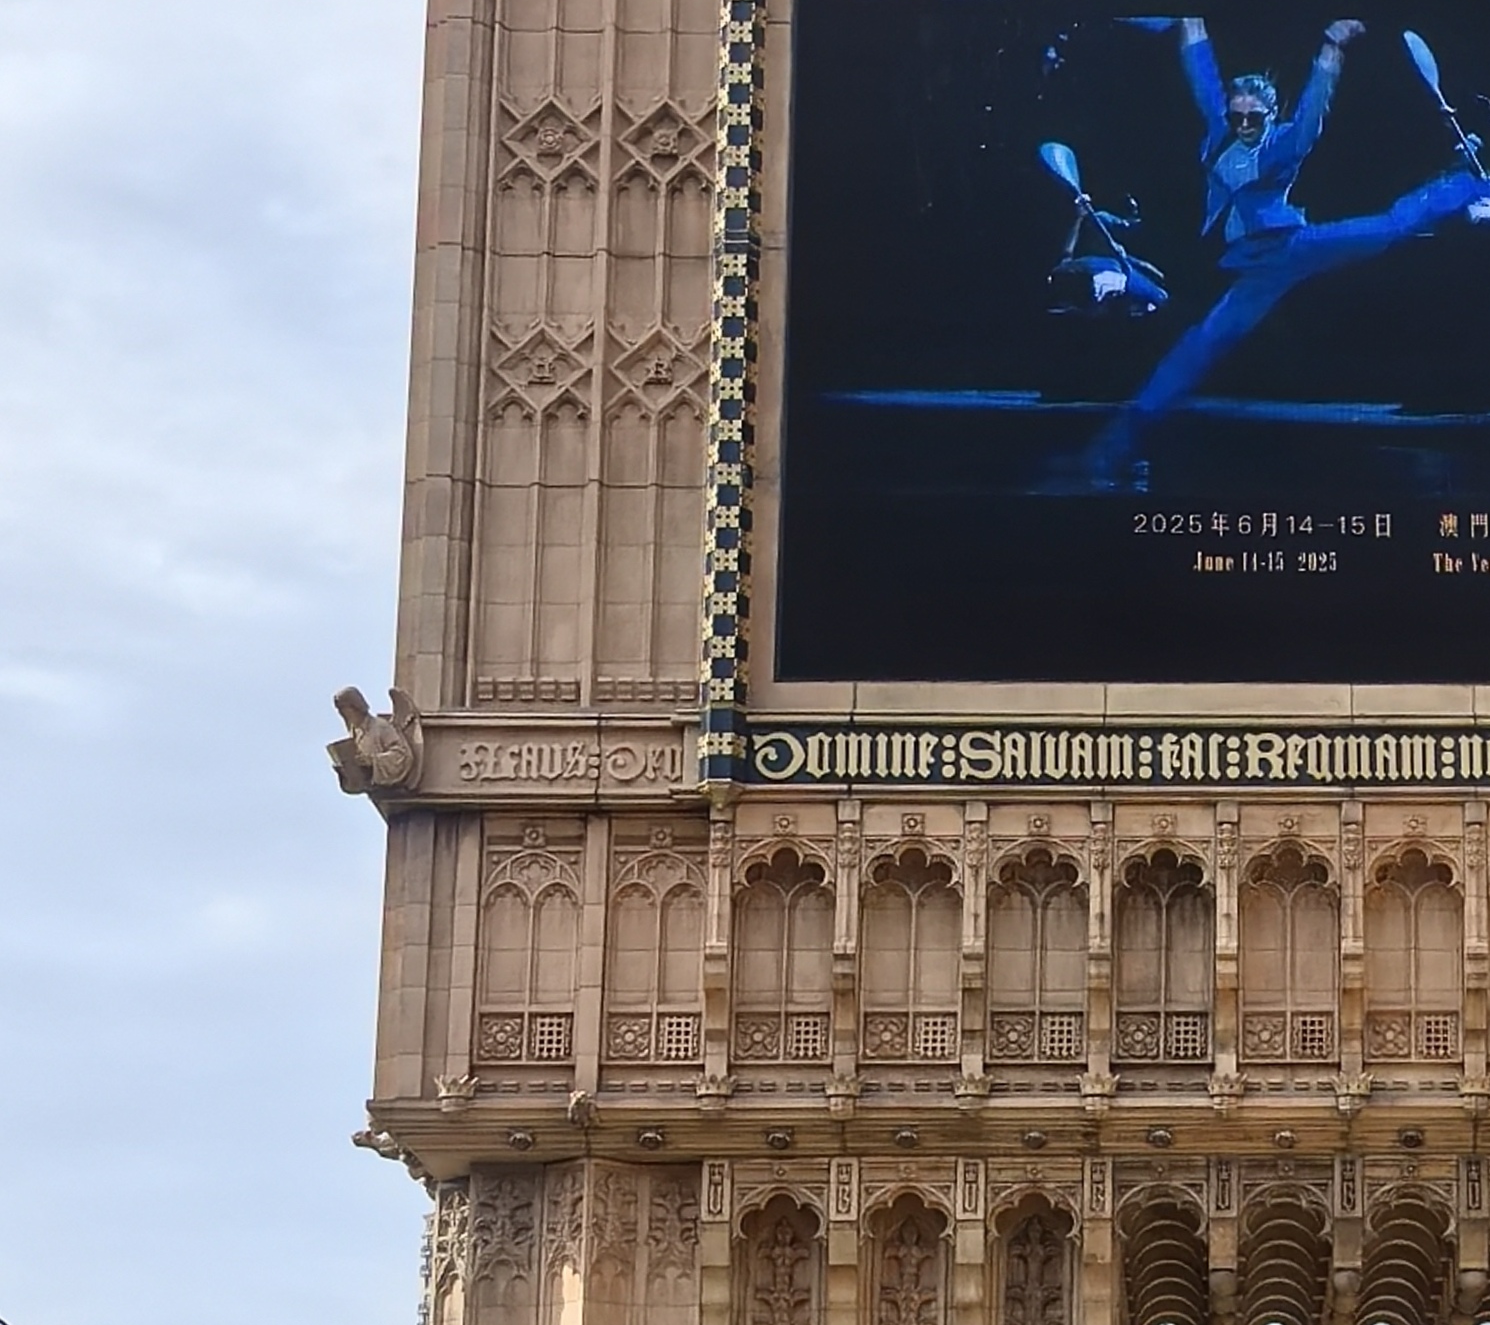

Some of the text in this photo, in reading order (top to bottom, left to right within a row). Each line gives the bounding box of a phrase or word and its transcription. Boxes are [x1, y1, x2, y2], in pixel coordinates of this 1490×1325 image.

[1193, 551, 1234, 572] June
[1298, 551, 1337, 572] 2025
[1433, 553, 1463, 574] The
